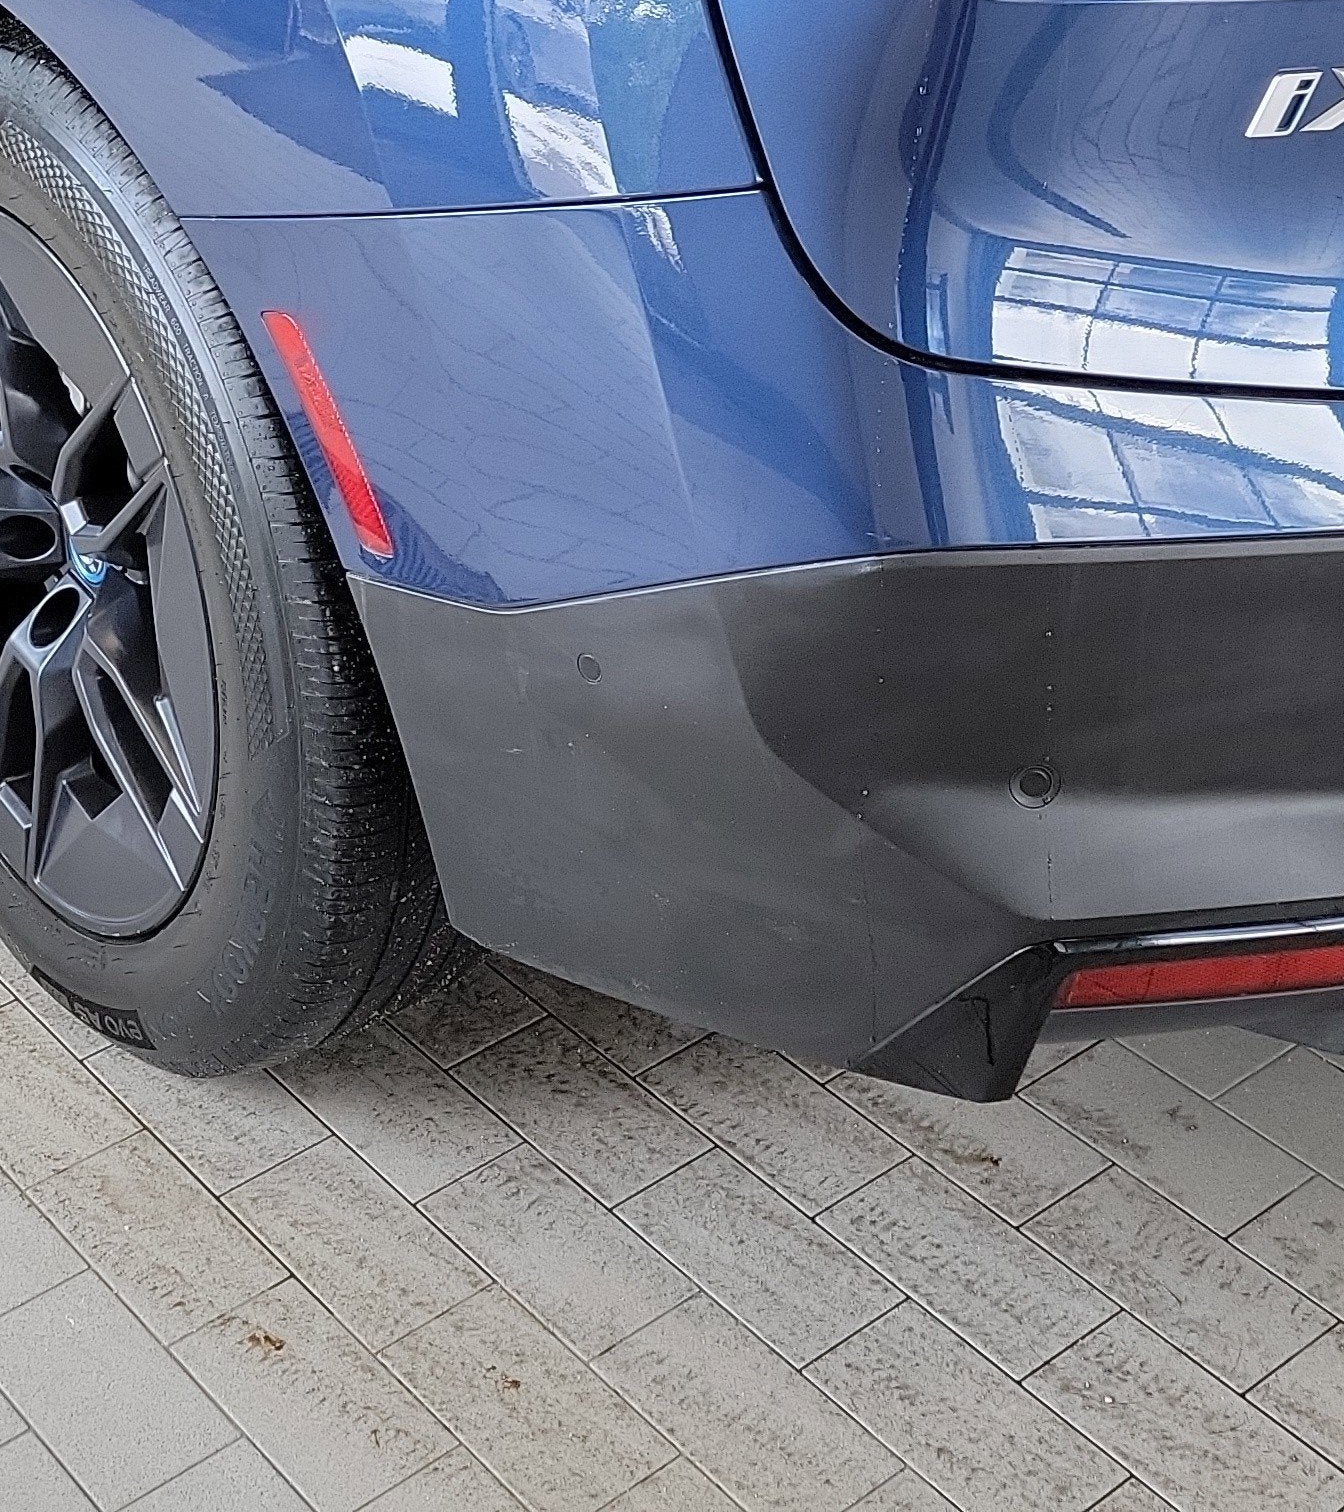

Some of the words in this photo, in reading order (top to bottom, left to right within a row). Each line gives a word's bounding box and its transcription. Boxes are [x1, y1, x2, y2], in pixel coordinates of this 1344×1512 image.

[141, 264, 172, 314] TREADWEAR
[169, 316, 182, 336] 600
[182, 343, 205, 388] TRACTION
